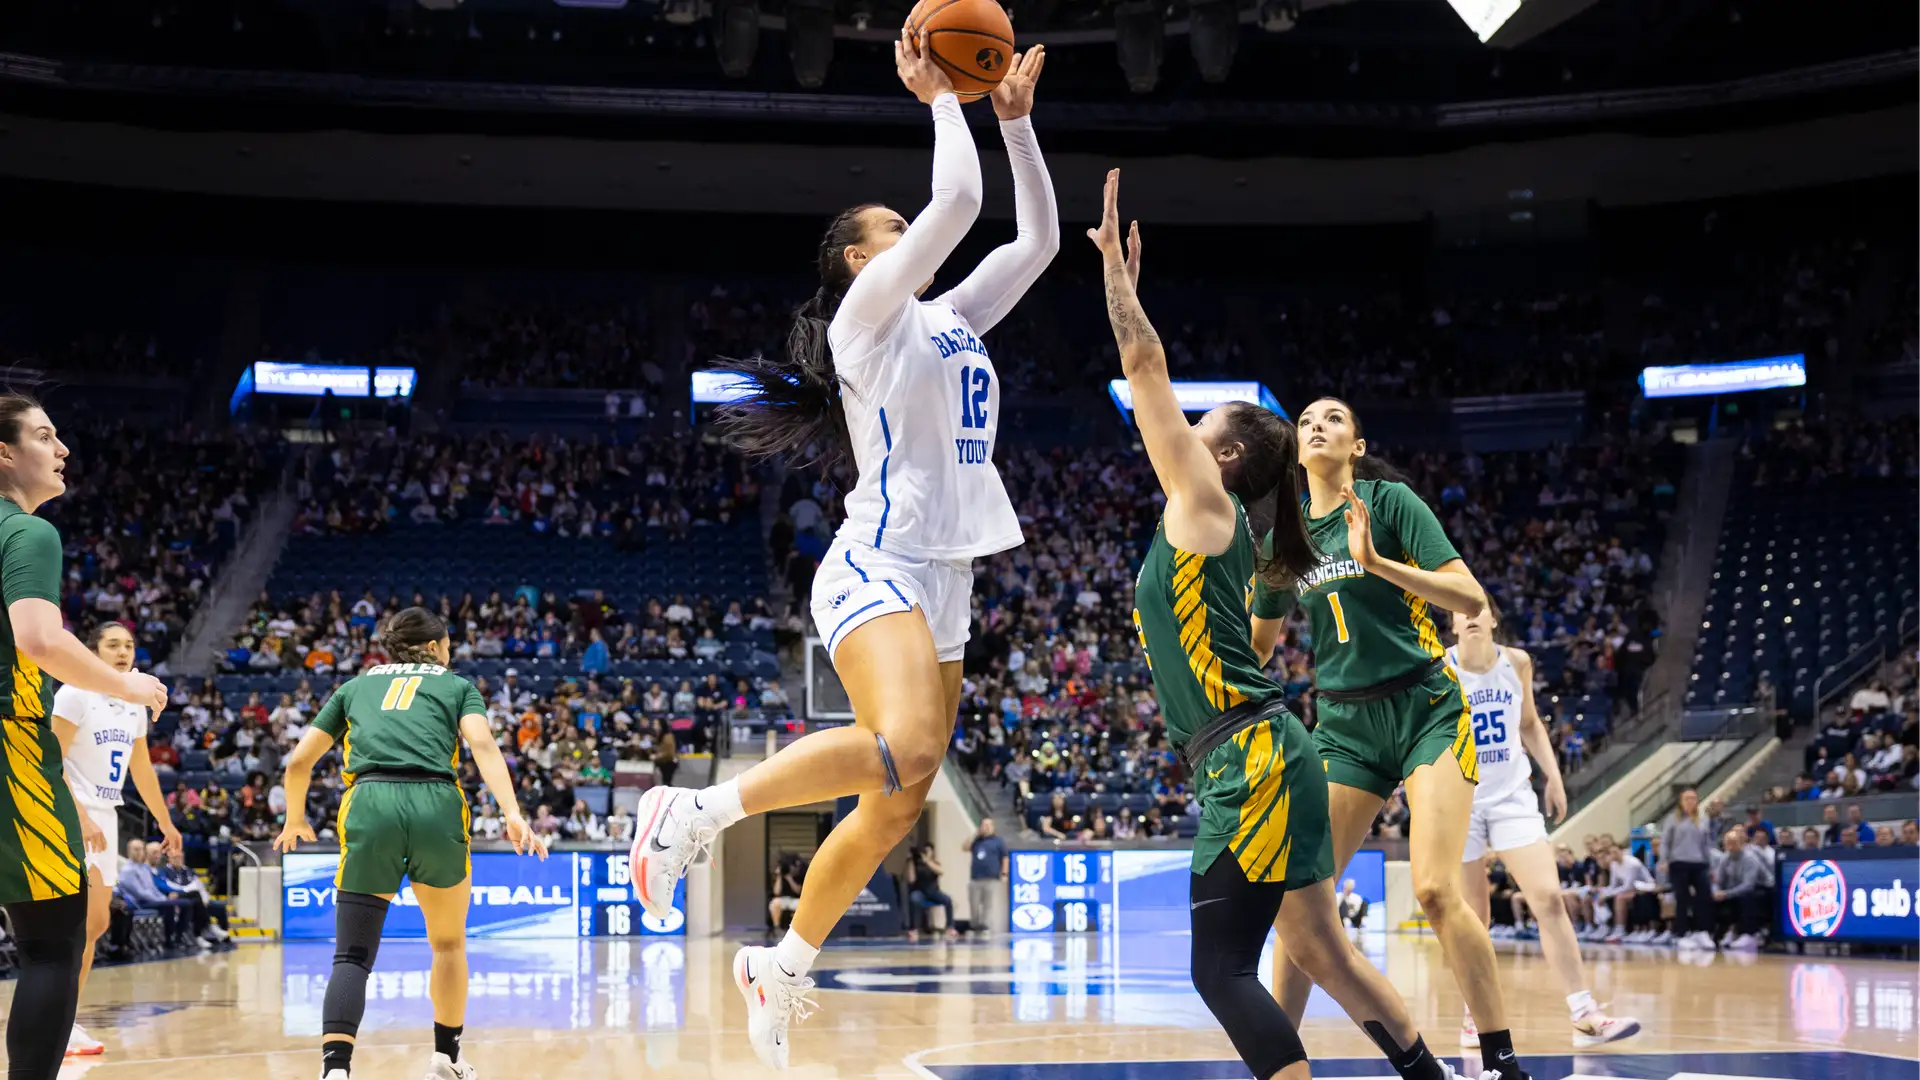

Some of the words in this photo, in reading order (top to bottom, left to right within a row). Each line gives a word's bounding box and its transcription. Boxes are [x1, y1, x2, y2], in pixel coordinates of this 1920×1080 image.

[931, 328, 988, 359] BRIGHA
[961, 366, 990, 429] 12
[955, 438, 989, 464] YOUN
[1327, 591, 1350, 644] 1
[366, 663, 447, 676] GAYLES
[381, 675, 424, 711] 11
[1466, 688, 1513, 706] RIGHAM
[1472, 709, 1506, 746] 25
[109, 750, 123, 782] 5
[606, 855, 630, 885] 15
[1063, 854, 1087, 883] 15
[1852, 888, 1867, 917] a
[1870, 879, 1911, 918] sub
[606, 905, 631, 935] 16
[1063, 902, 1088, 932] 16
